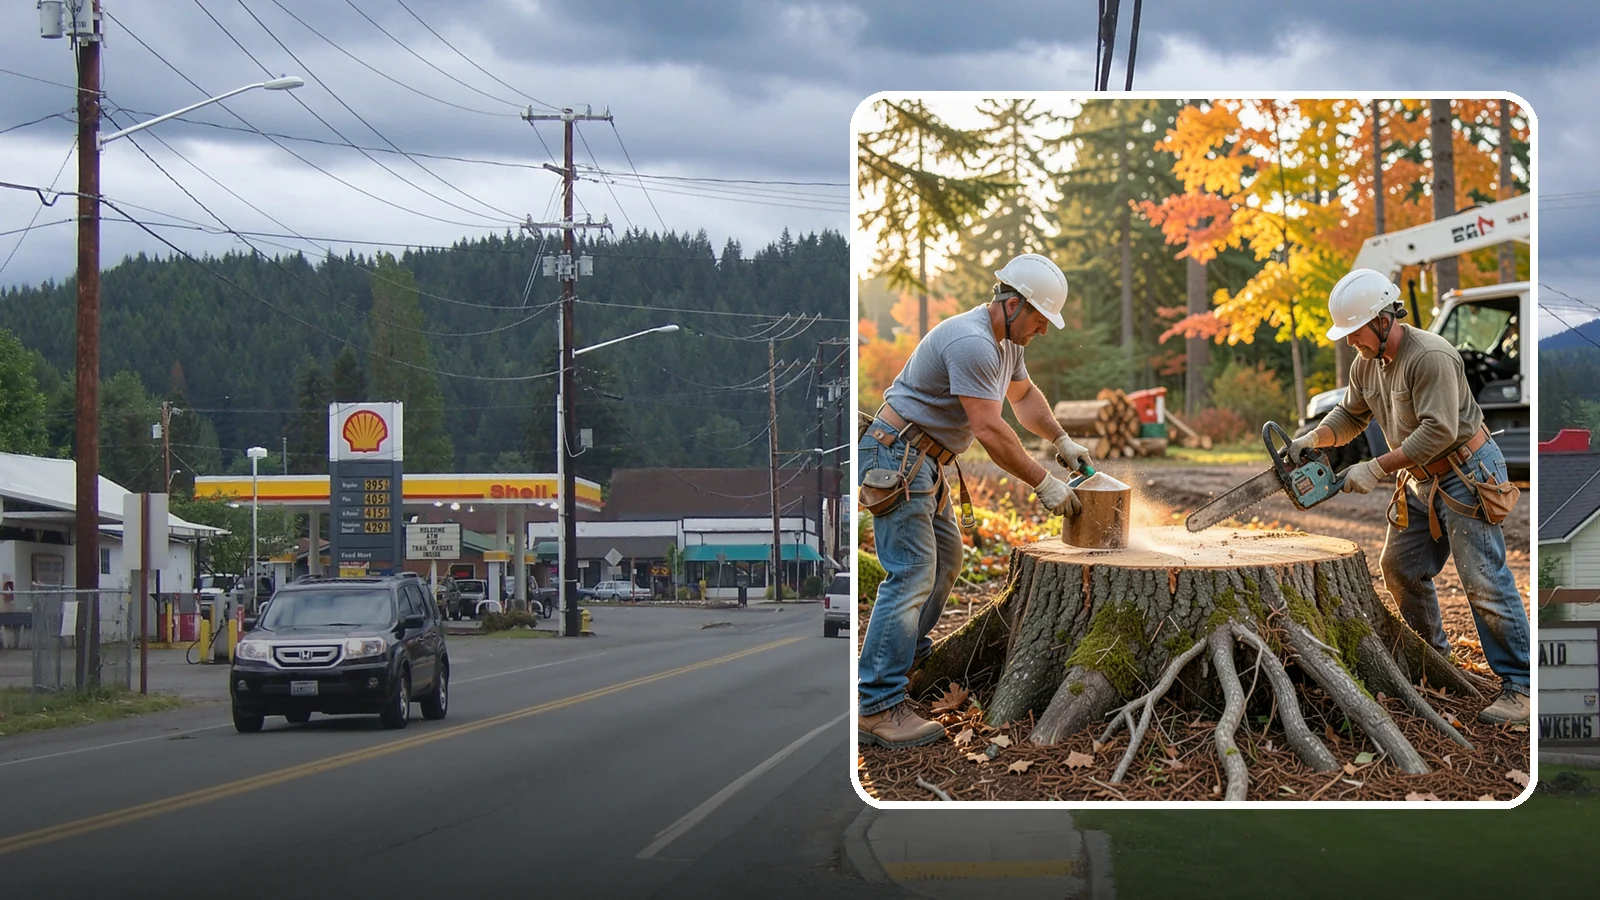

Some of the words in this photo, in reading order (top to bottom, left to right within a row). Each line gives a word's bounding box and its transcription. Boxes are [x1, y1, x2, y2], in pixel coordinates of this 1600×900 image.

[366, 480, 383, 490] 395
[490, 485, 546, 498] Shell
[366, 494, 383, 504] 405
[366, 508, 383, 518] 415
[366, 522, 383, 532] 429
